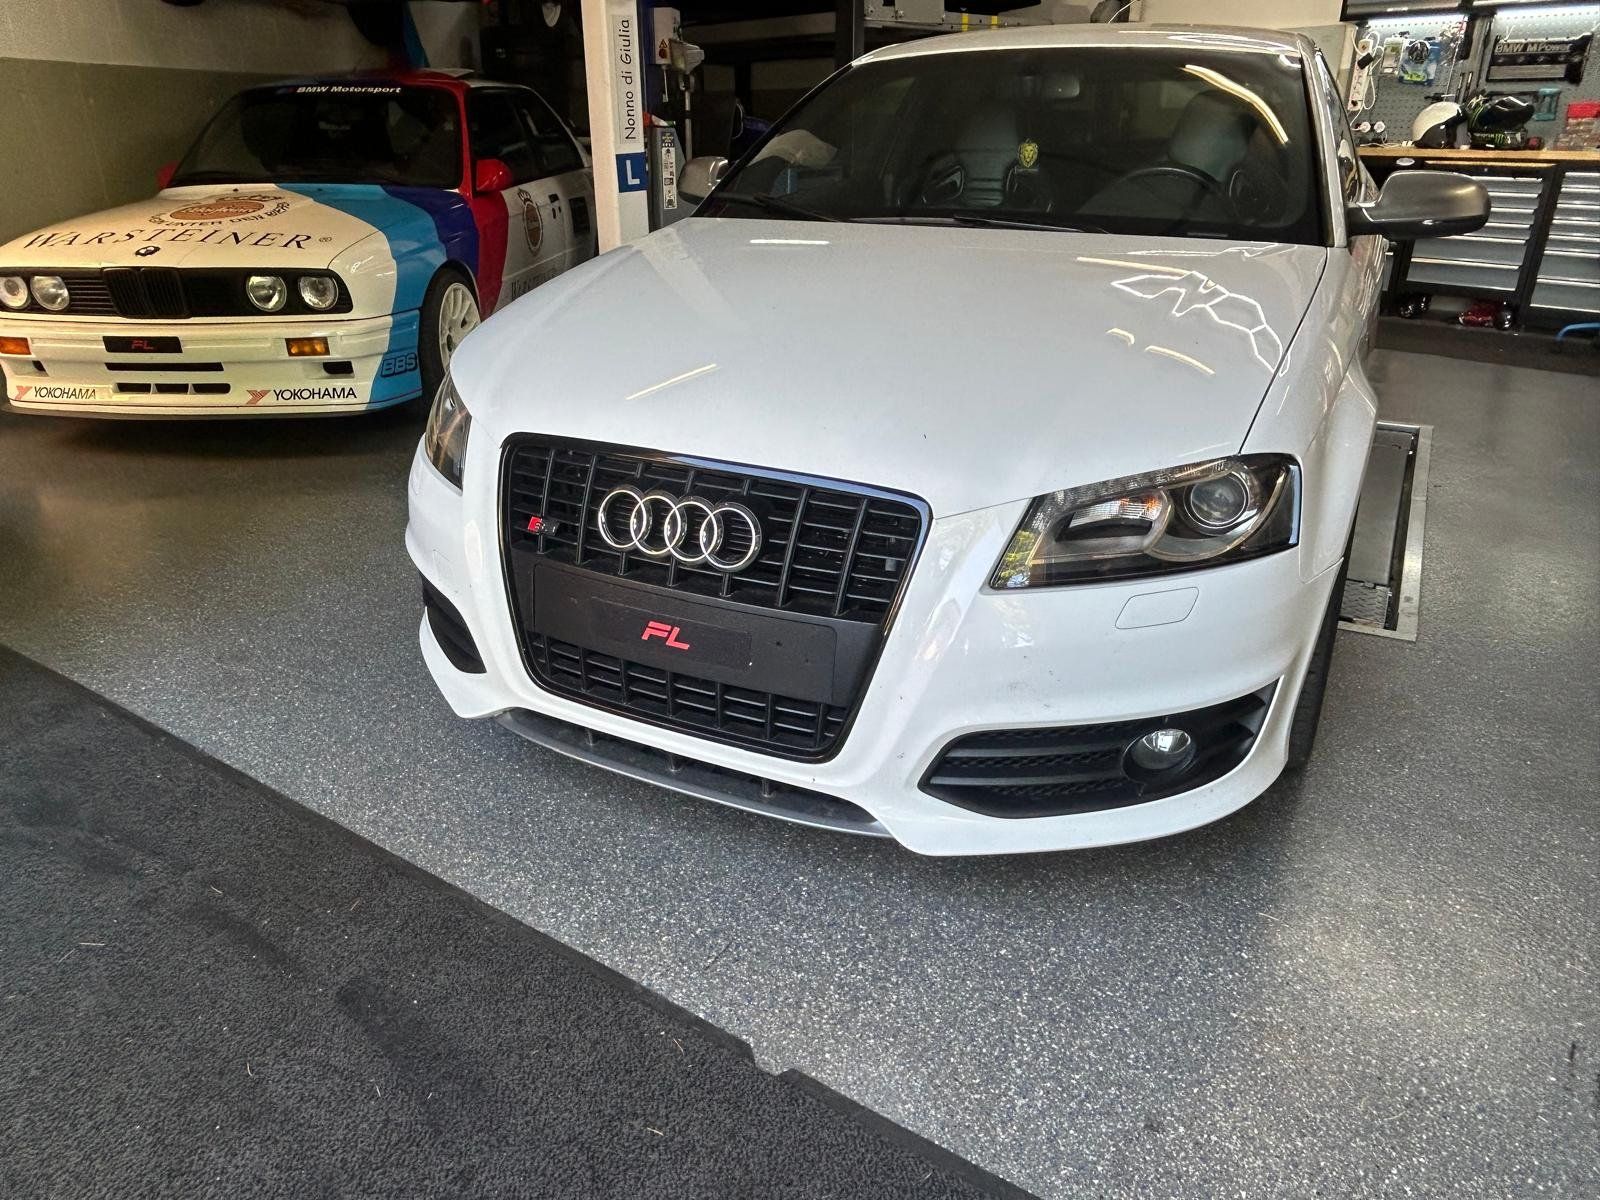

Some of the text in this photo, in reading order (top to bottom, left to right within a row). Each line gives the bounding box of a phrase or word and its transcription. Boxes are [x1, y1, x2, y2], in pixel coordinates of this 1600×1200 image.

[330, 86, 402, 94] Motorsport
[618, 19, 637, 140] Nonno di Giulia
[625, 159, 641, 185] L
[23, 228, 313, 250] WARSTEINER
[381, 353, 418, 377] BBS
[34, 386, 97, 400] YOKOHAMA
[273, 386, 357, 401] YOKOHAMA
[641, 620, 690, 650] FL
